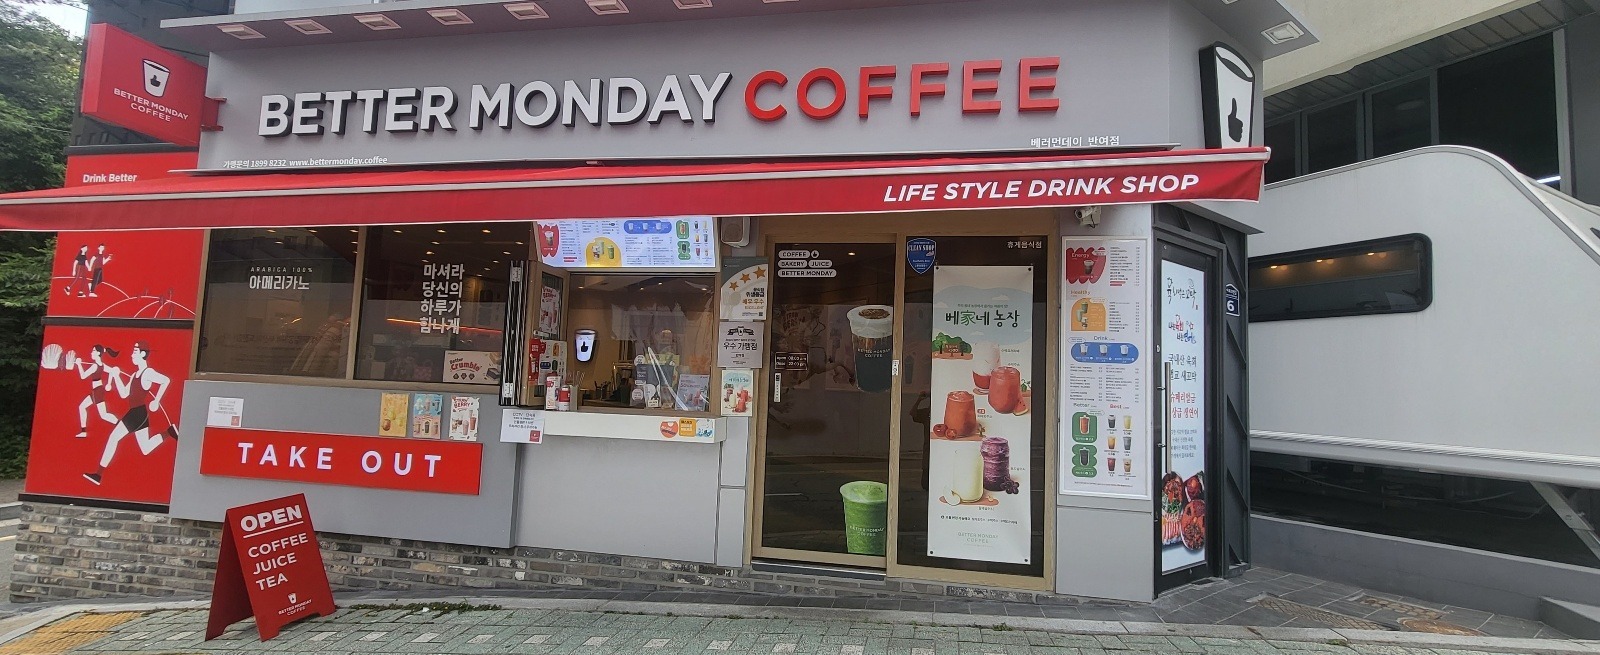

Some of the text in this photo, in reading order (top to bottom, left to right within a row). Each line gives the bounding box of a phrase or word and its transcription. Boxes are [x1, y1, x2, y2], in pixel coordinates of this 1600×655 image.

[113, 87, 189, 120] BETTER MONDAY
[258, 57, 1060, 137] BETTER MONDAY COFFEE
[130, 102, 171, 122] COFFEE
[1030, 135, 1120, 148] 베러먼데이 반여점
[223, 156, 388, 169] 가맹문의 1899 8232 www.bettermonday.coffee
[83, 173, 137, 183] Drink Better
[884, 174, 1199, 202] LIFE STYLE DRINK SHOP
[1007, 241, 1042, 249] 휴게음식점
[423, 263, 465, 280] 마셔라
[249, 275, 310, 290] 아메리카노
[422, 281, 462, 298] 당신의
[420, 299, 462, 316] 하루가
[1227, 300, 1235, 311] 6
[419, 316, 460, 335] 힘나게
[945, 309, 1020, 328] 베家네 농장
[723, 342, 758, 351] 우수 가맹점
[1168, 353, 1197, 367] 국내산 육회
[238, 442, 442, 477] TAKE OUT
[240, 504, 303, 532] OPEN
[248, 532, 308, 558] COFFEE
[252, 552, 297, 575] JUICE
[255, 572, 288, 591] TEA
